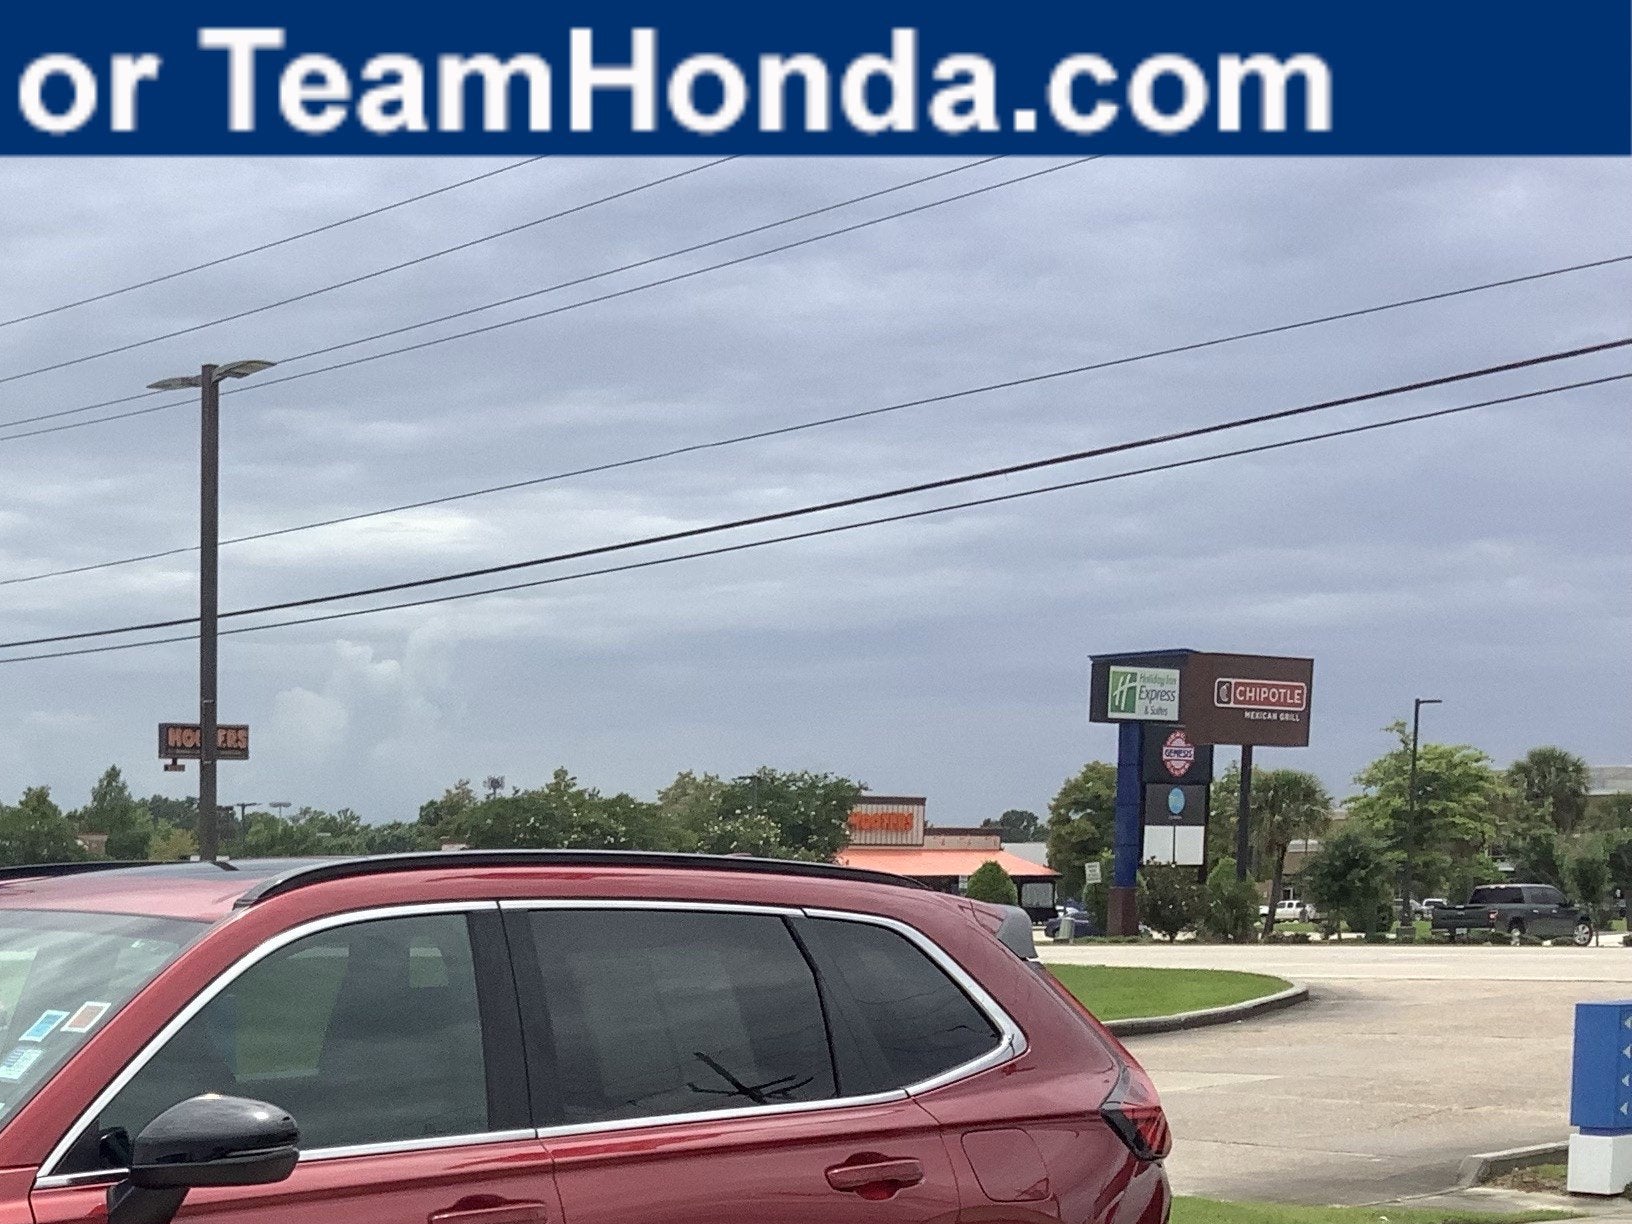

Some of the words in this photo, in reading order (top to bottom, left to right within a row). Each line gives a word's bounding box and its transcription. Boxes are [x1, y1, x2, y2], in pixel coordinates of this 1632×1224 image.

[1138, 685, 1176, 704] Express
[1235, 686, 1302, 704] CHIPOTLE
[1150, 705, 1168, 716] Suites
[1244, 711, 1277, 721] MEXICAN
[1279, 713, 1300, 722] GRILL
[1164, 747, 1193, 759] GENESIS
